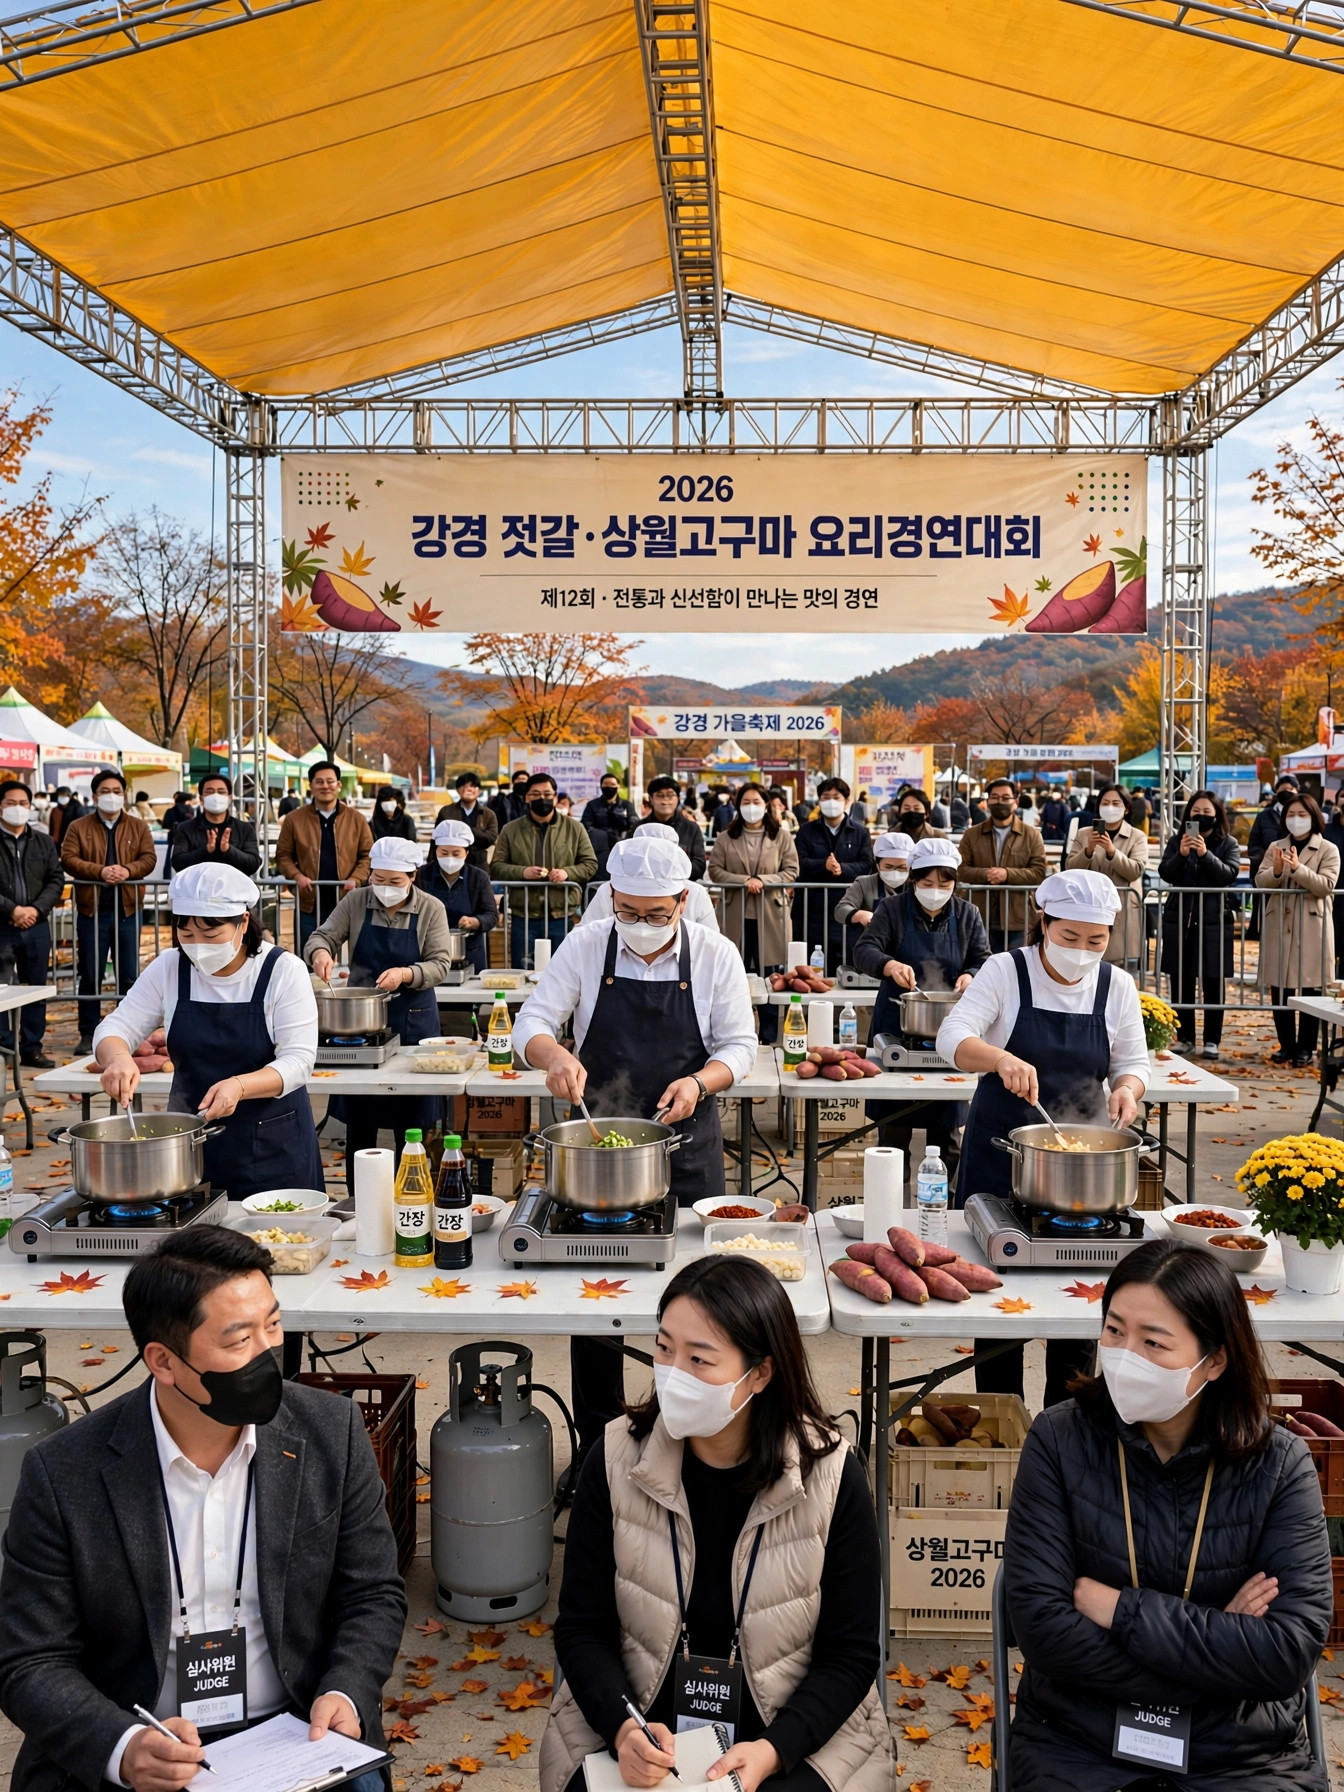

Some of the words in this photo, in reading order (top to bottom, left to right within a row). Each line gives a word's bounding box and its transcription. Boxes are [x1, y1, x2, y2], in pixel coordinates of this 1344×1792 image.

[659, 475, 734, 503] 2026
[412, 514, 487, 558] 강경
[808, 514, 1041, 558] 요리경연대회
[541, 588, 595, 609] 제12회
[614, 588, 666, 609] 전통과
[671, 588, 740, 609] 신선함이
[746, 588, 799, 609] 만나는
[804, 588, 838, 609] 맛의
[844, 588, 878, 609] 경연
[674, 713, 708, 732] 강경
[713, 713, 780, 732] 가을축제
[787, 716, 824, 730] 2026
[477, 1109, 502, 1119] 2026
[820, 1111, 847, 1121] 2026
[399, 1210, 425, 1227] 간장
[438, 1214, 464, 1230] 간장
[930, 1567, 986, 1589] 2026
[186, 1655, 236, 1678] 심사위원
[194, 1676, 229, 1692] JUDGE
[684, 1680, 730, 1700] 심사위원
[690, 1699, 722, 1714] JUDGE
[1135, 1711, 1171, 1728] JUDGE
